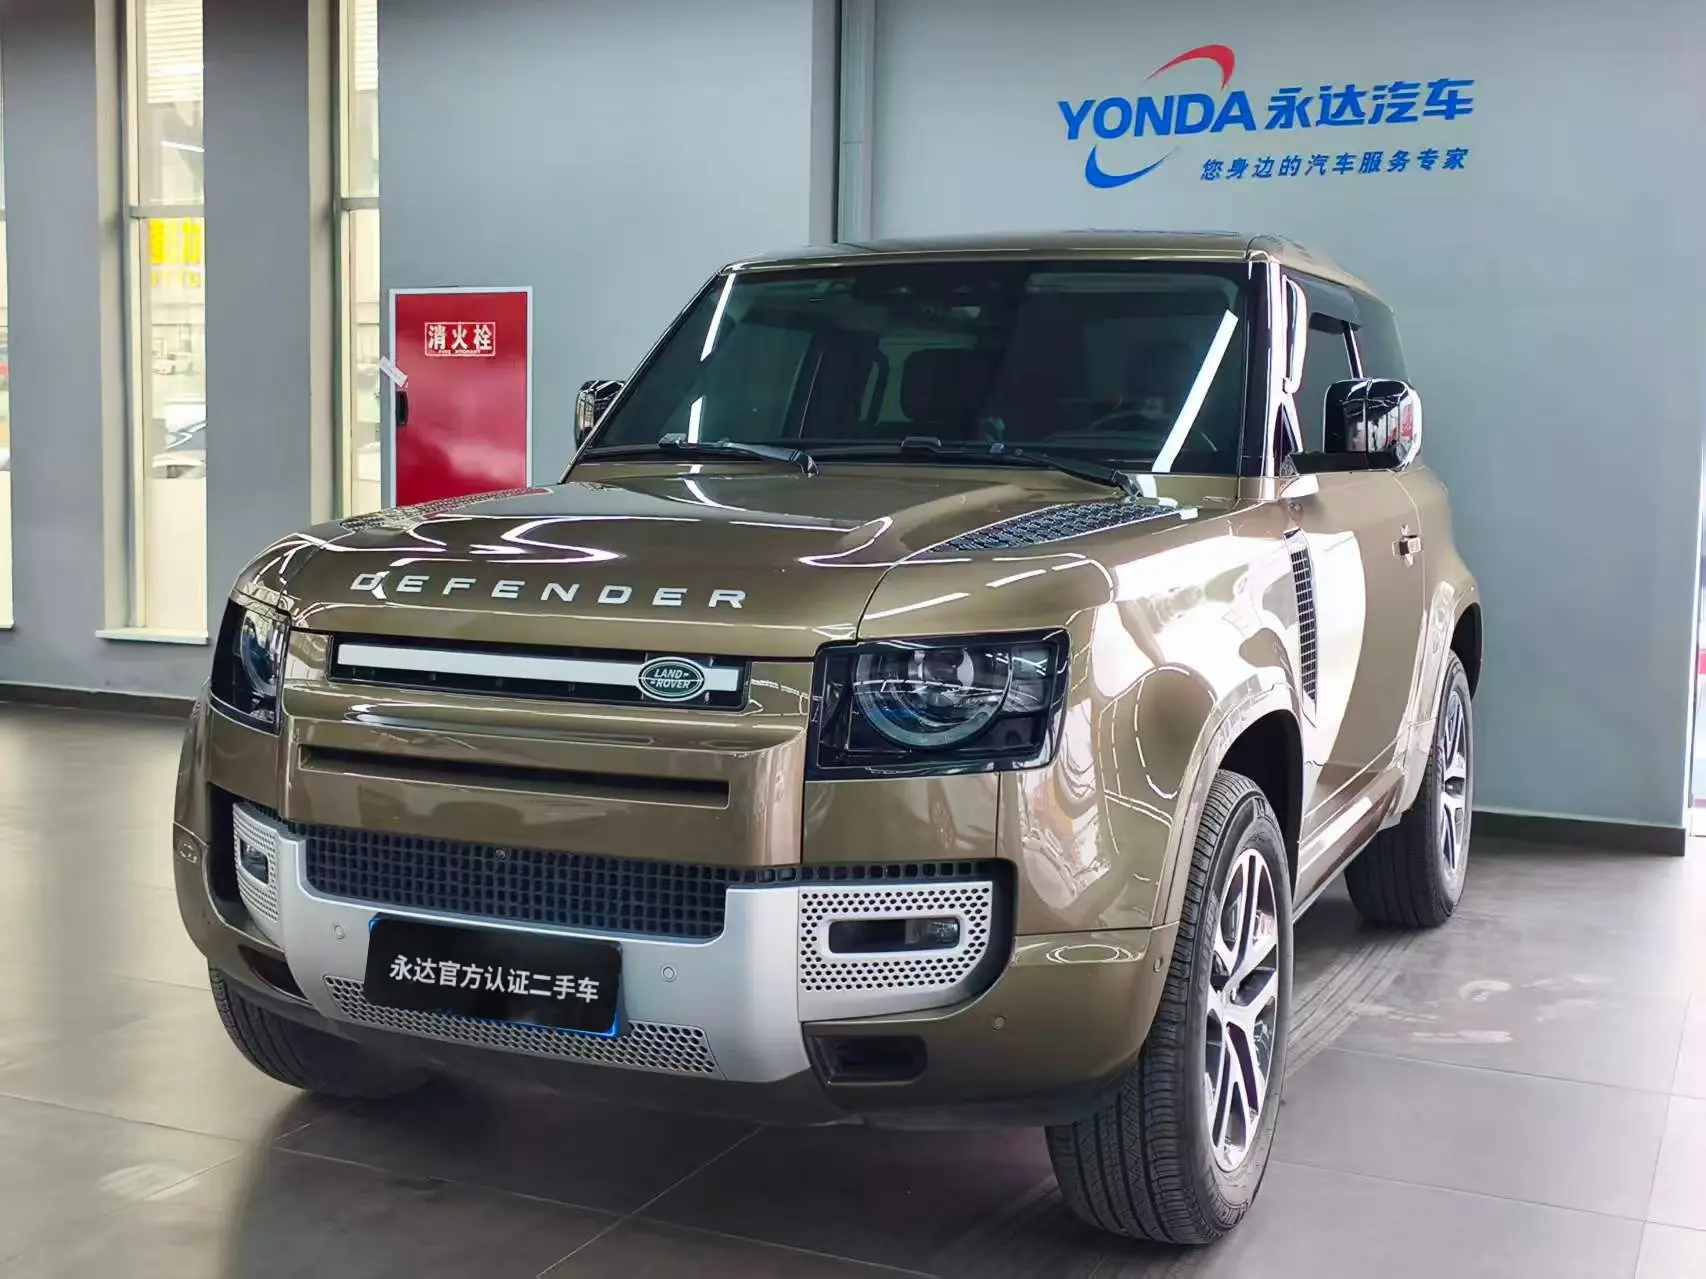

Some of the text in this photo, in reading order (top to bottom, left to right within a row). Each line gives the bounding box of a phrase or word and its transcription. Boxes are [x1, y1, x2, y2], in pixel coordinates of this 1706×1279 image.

[1058, 78, 1476, 140] YONDA 永达汽车
[1200, 147, 1470, 181] 您身边的汽车服务专家
[428, 322, 492, 350] 消火栓
[350, 573, 747, 609] DEFENDER
[389, 954, 600, 1003] 永达官方认证二手车
